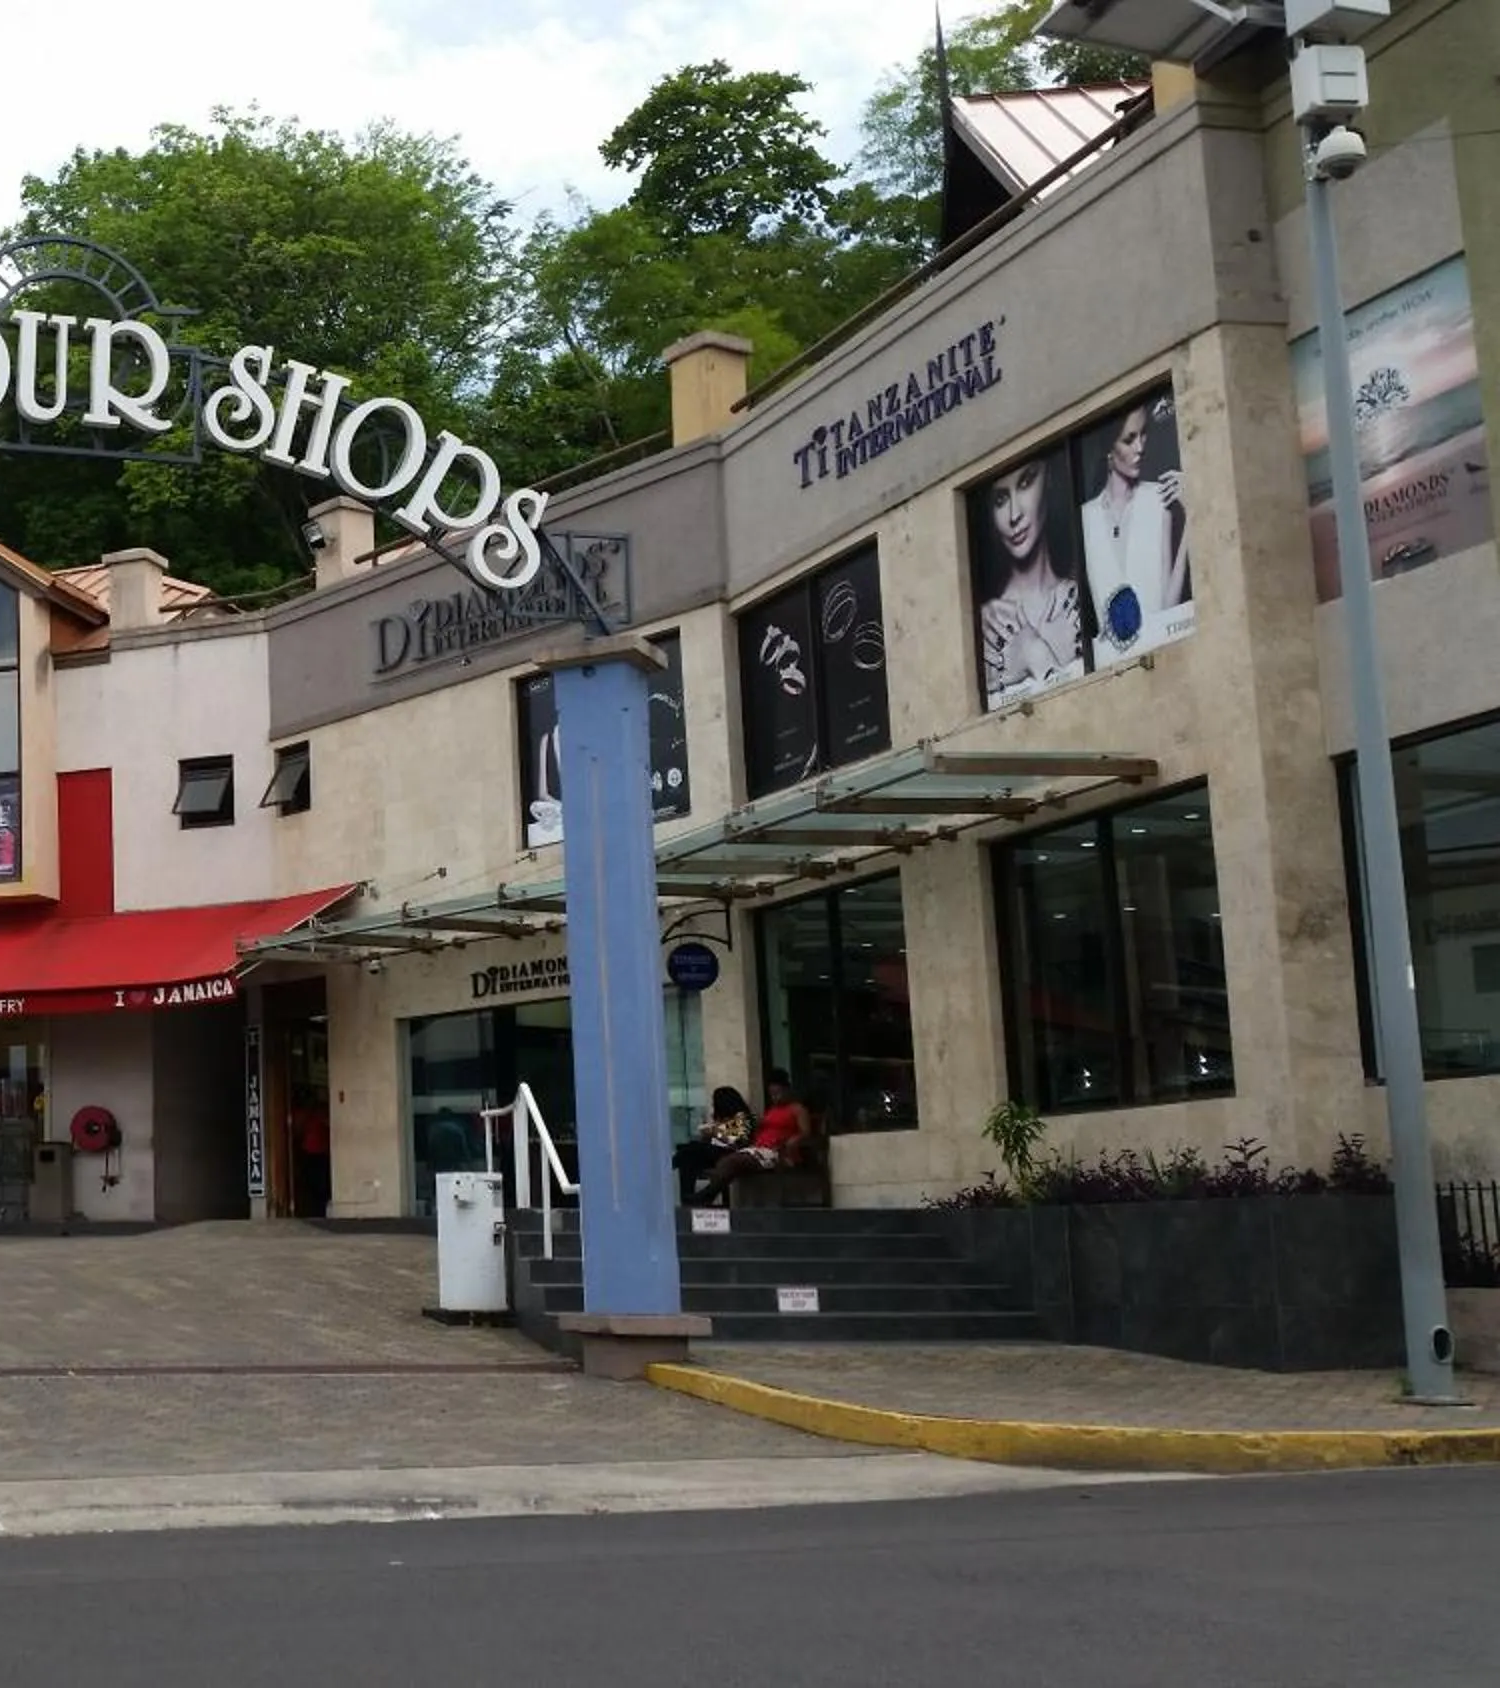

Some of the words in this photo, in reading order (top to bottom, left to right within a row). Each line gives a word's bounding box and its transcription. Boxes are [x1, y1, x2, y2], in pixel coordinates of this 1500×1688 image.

[830, 320, 997, 450] TANZANITE
[836, 355, 1003, 480] INTERNATIONAL
[202, 345, 550, 589] SHOPS
[153, 978, 234, 1005] JAMAICA
